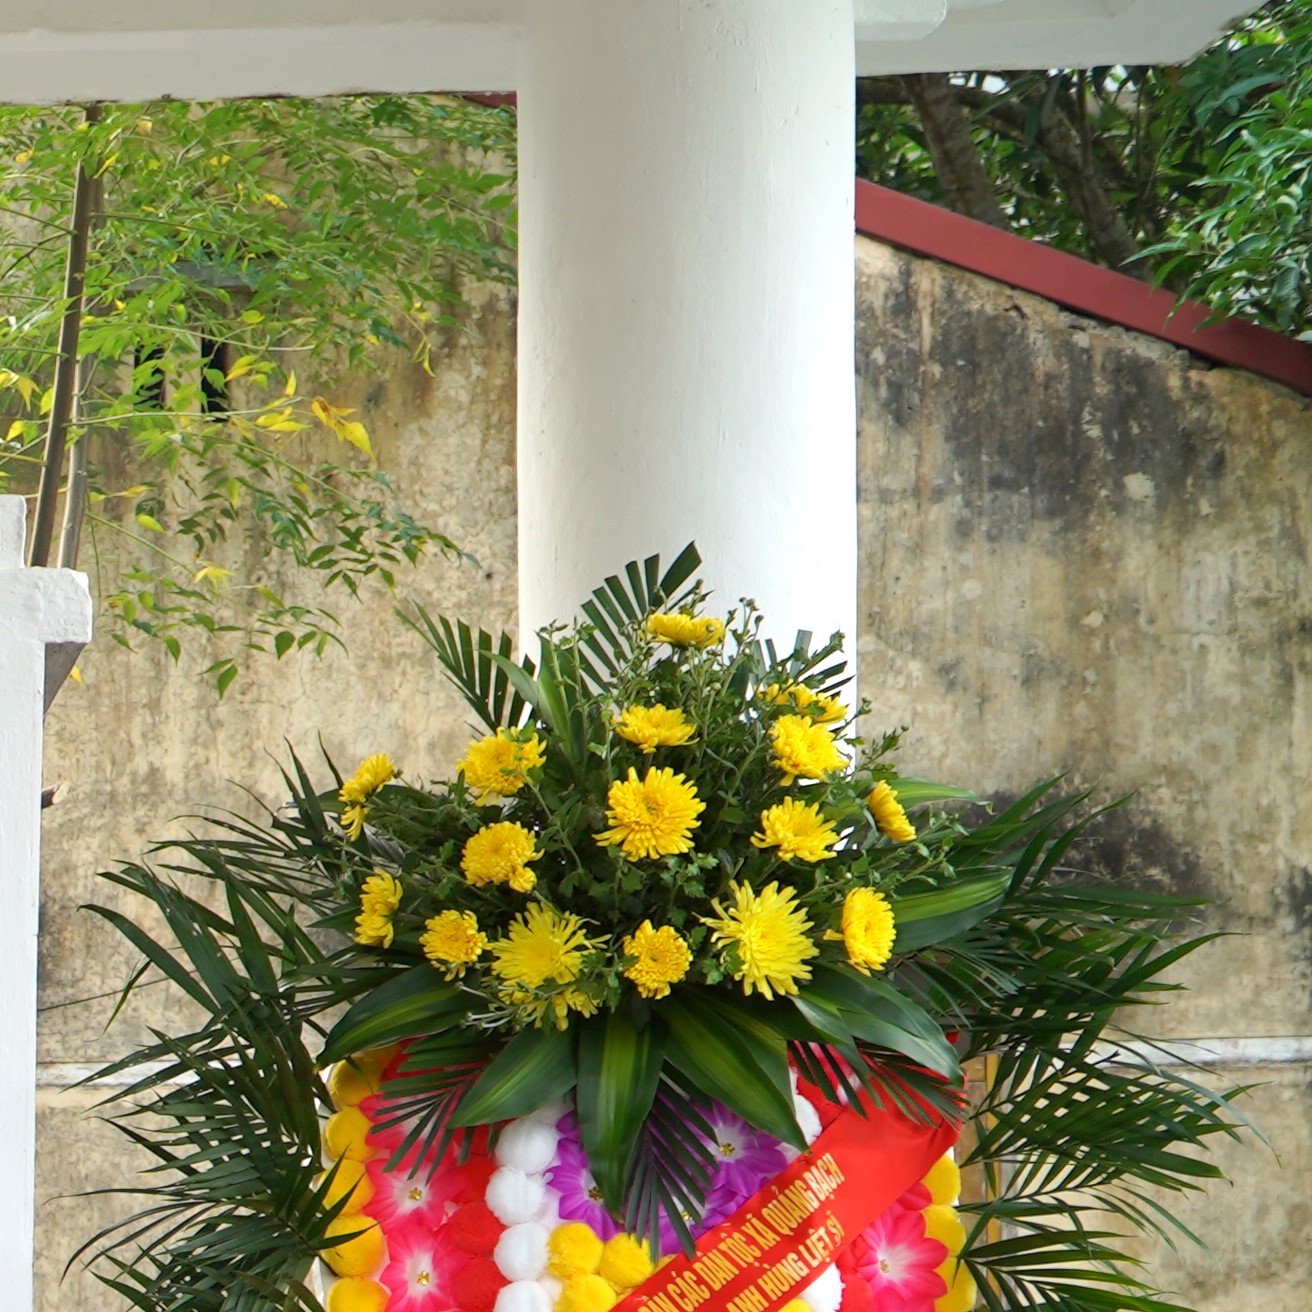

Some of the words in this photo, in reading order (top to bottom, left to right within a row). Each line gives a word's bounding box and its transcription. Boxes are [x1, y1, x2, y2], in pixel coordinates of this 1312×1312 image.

[667, 1271, 711, 1312] CÁC
[693, 1249, 740, 1291] DÂN
[718, 1232, 762, 1268] TỘC
[741, 1212, 781, 1250] XÃ
[761, 1180, 820, 1236] QUẢNG
[803, 1152, 845, 1201] BẠCH
[757, 1253, 810, 1300] HÙNG
[798, 1226, 834, 1268] LIỆT
